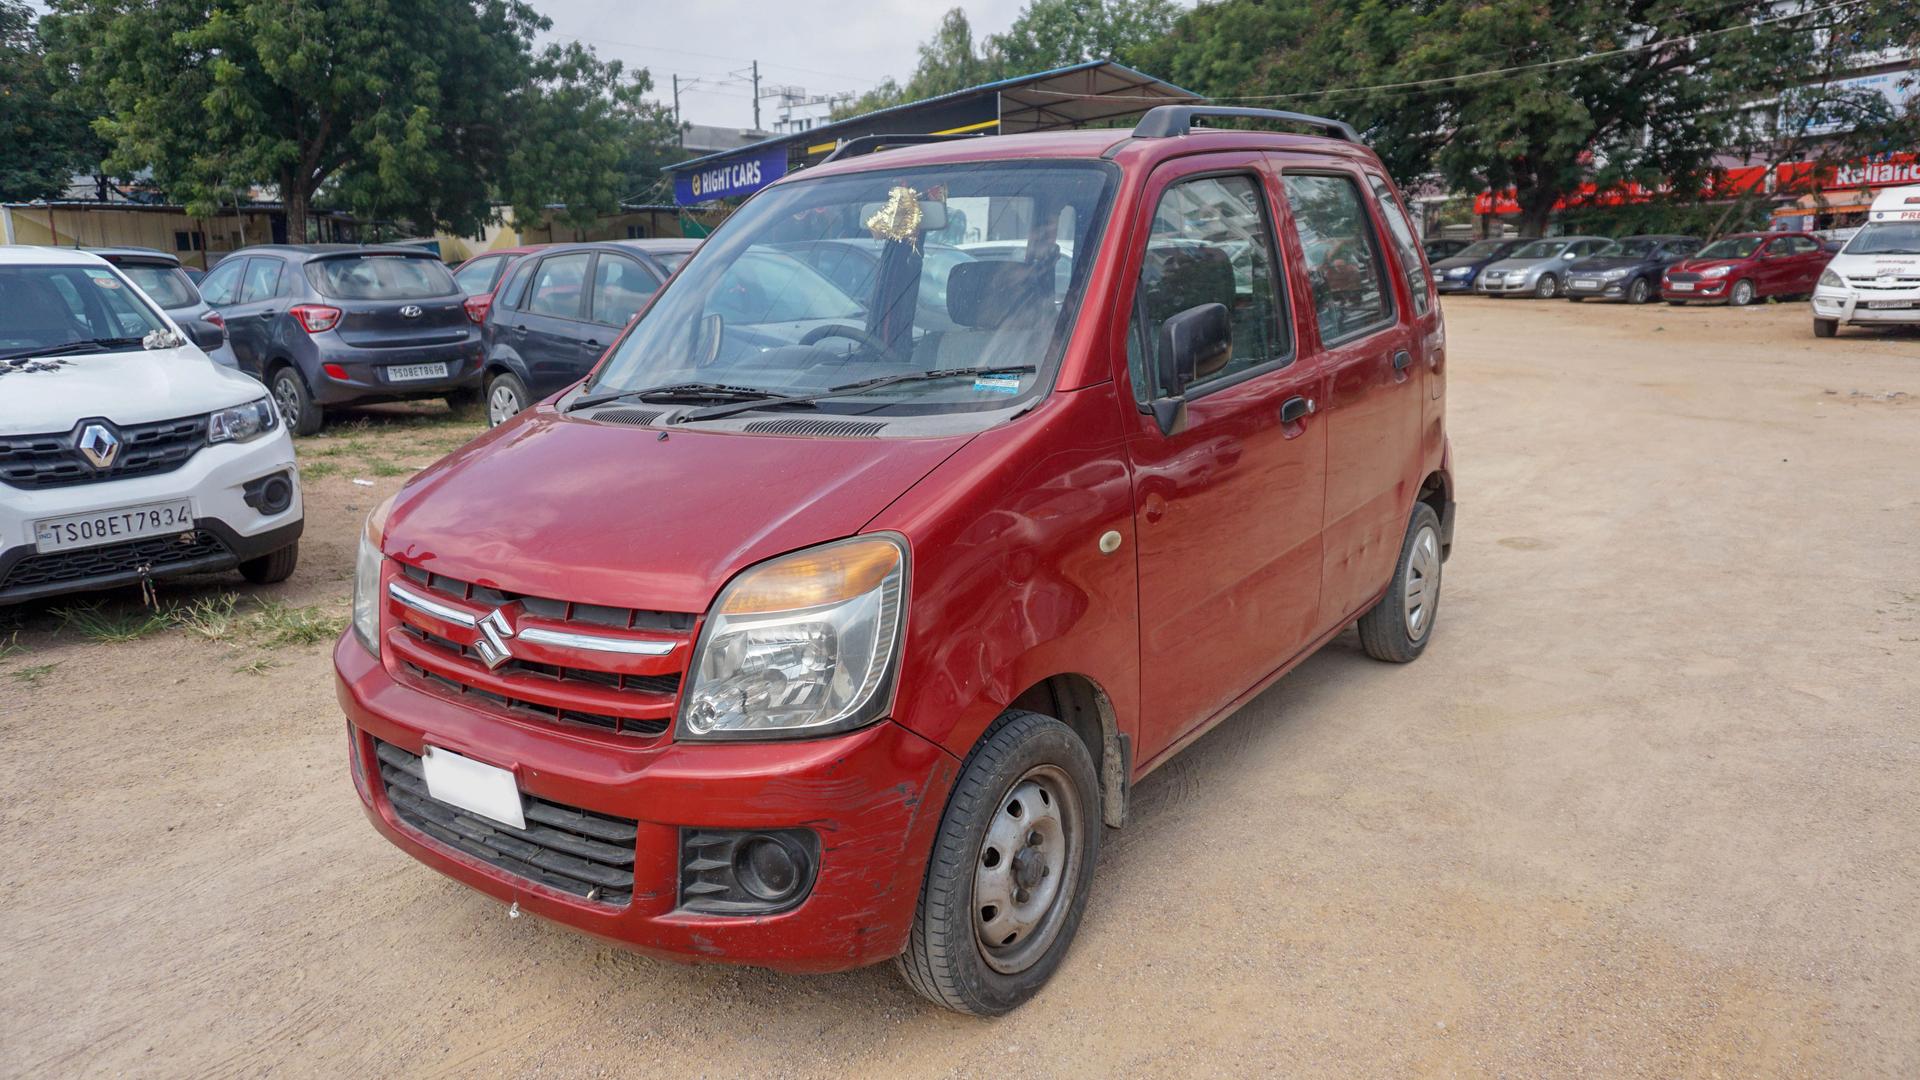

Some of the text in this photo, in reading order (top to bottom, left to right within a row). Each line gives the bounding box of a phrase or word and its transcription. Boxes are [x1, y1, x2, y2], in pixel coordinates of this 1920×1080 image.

[702, 160, 761, 194] RIGHT CARS
[50, 506, 188, 544] TS08ET7834
